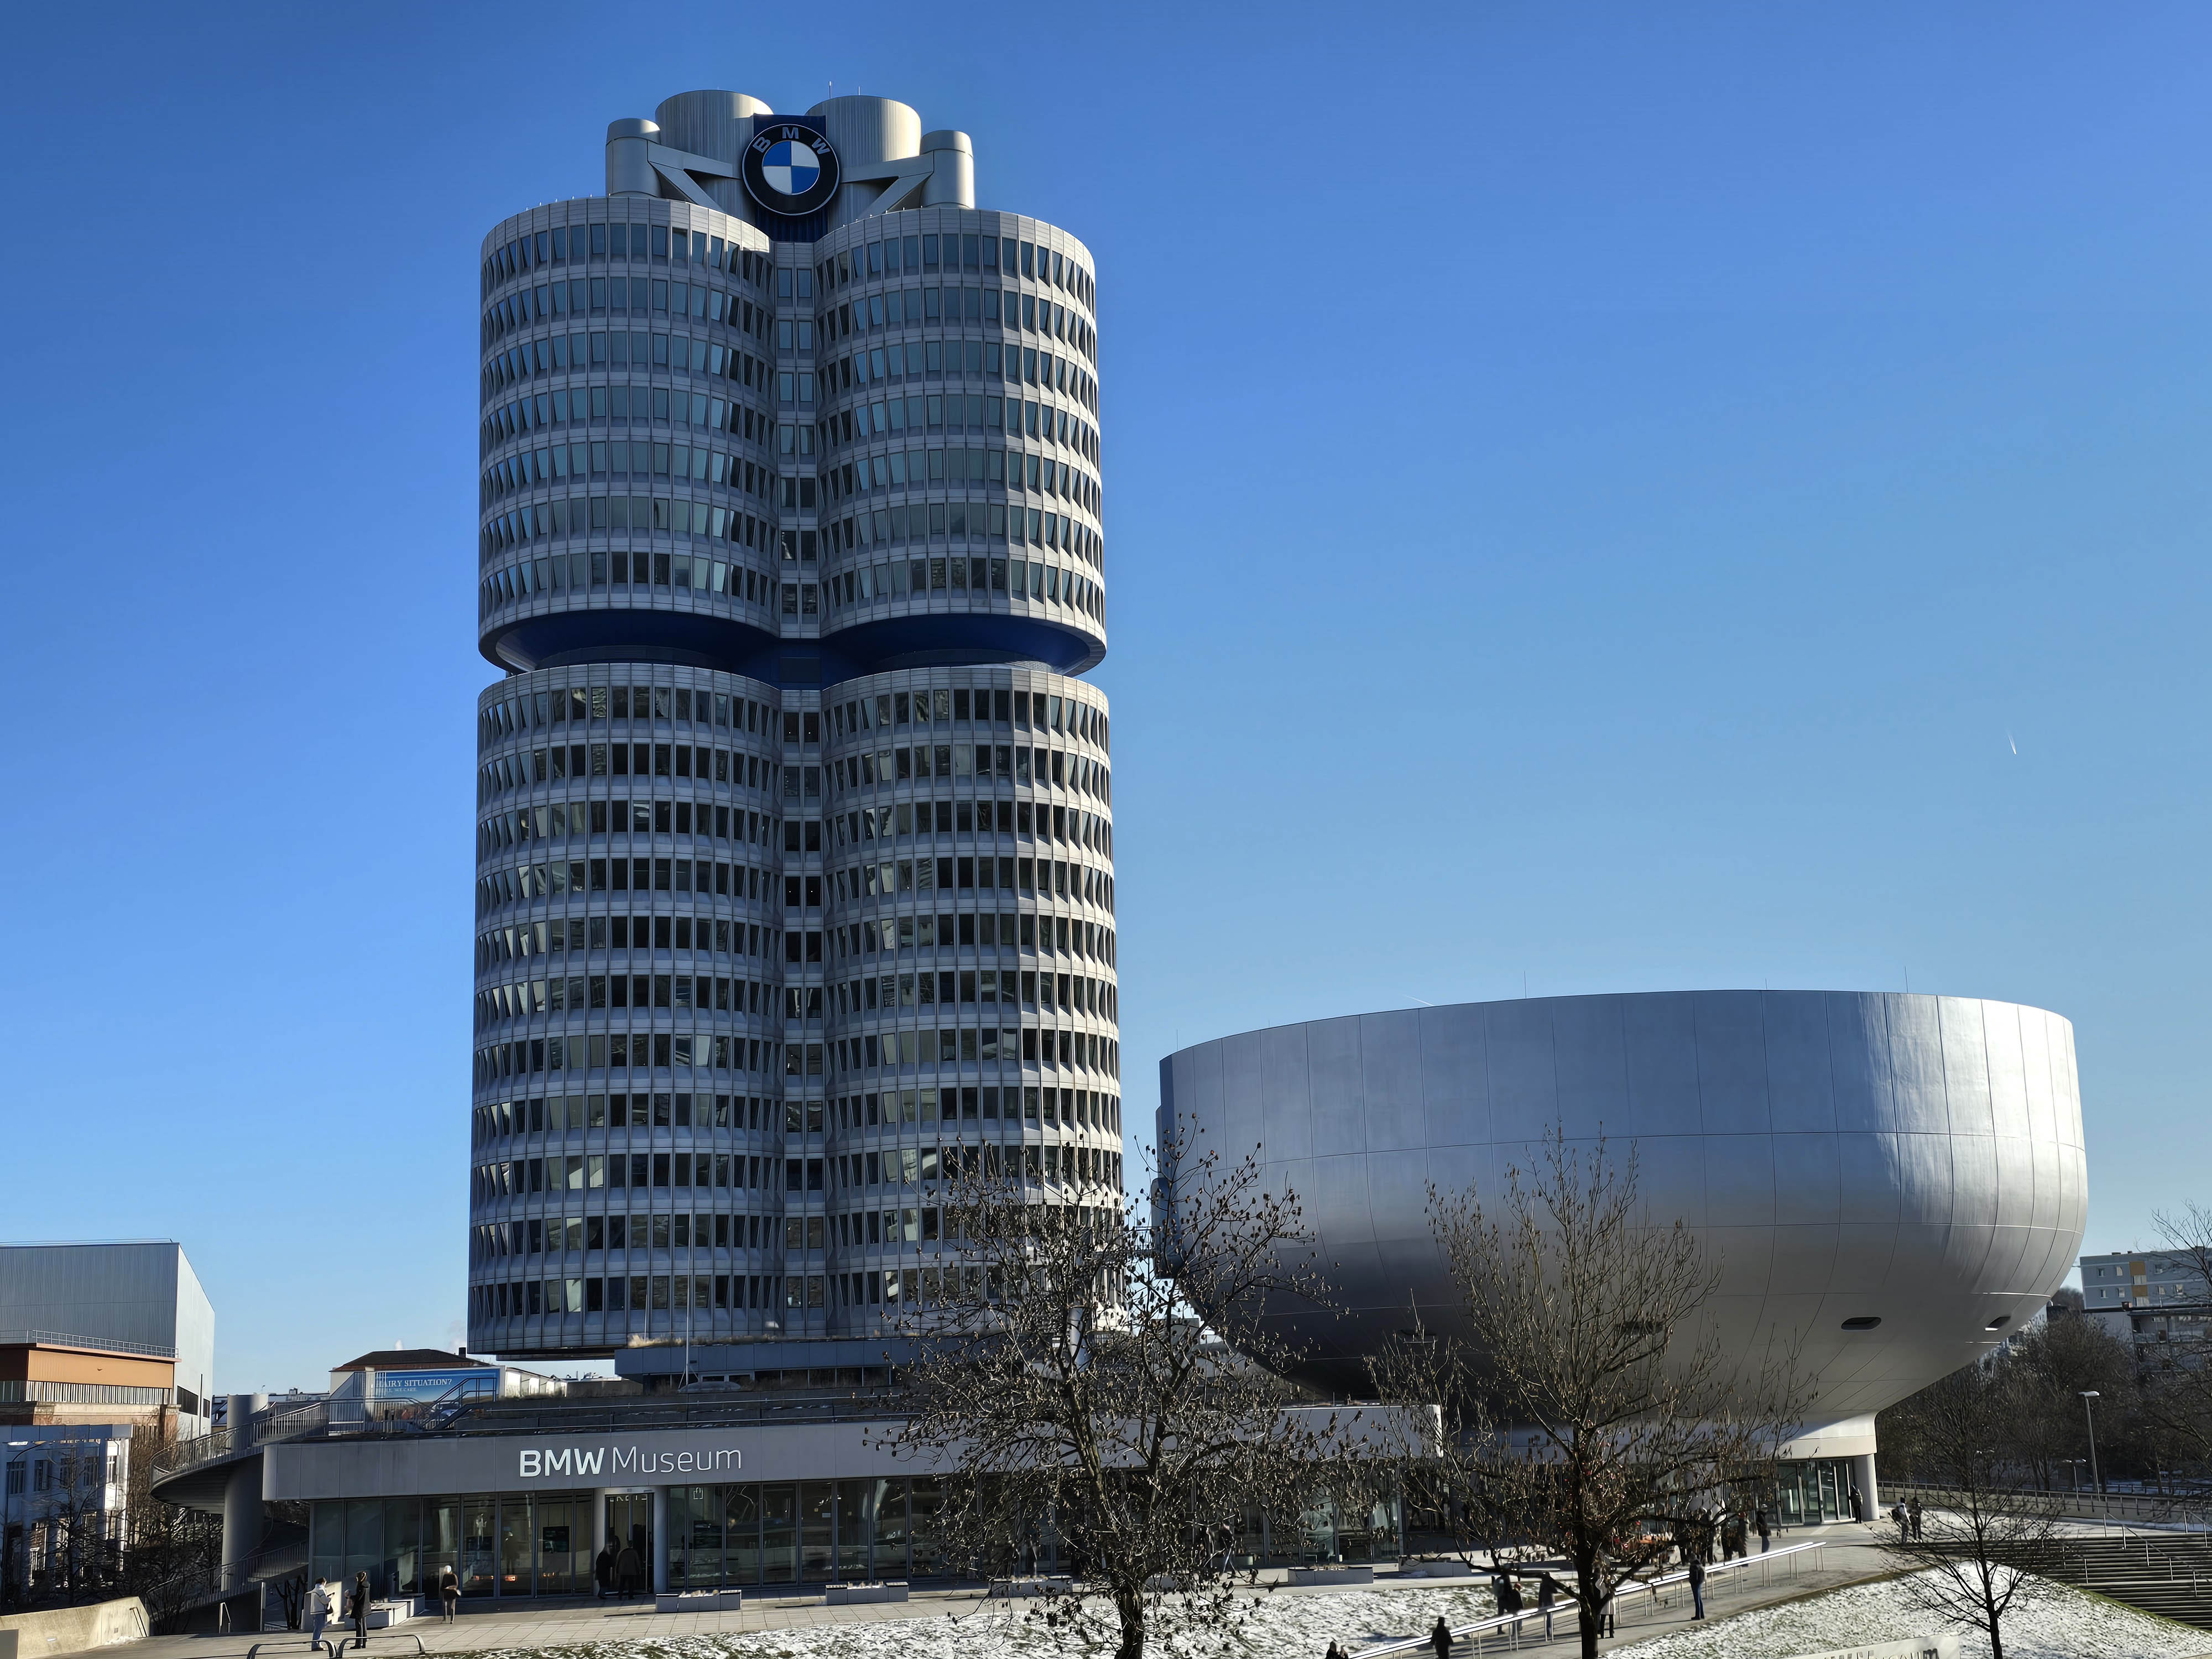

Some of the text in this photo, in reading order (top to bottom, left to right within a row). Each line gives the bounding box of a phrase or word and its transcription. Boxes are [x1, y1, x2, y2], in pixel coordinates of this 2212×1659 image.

[753, 127, 831, 155] BMW
[520, 1446, 741, 1477] BMW Museum
